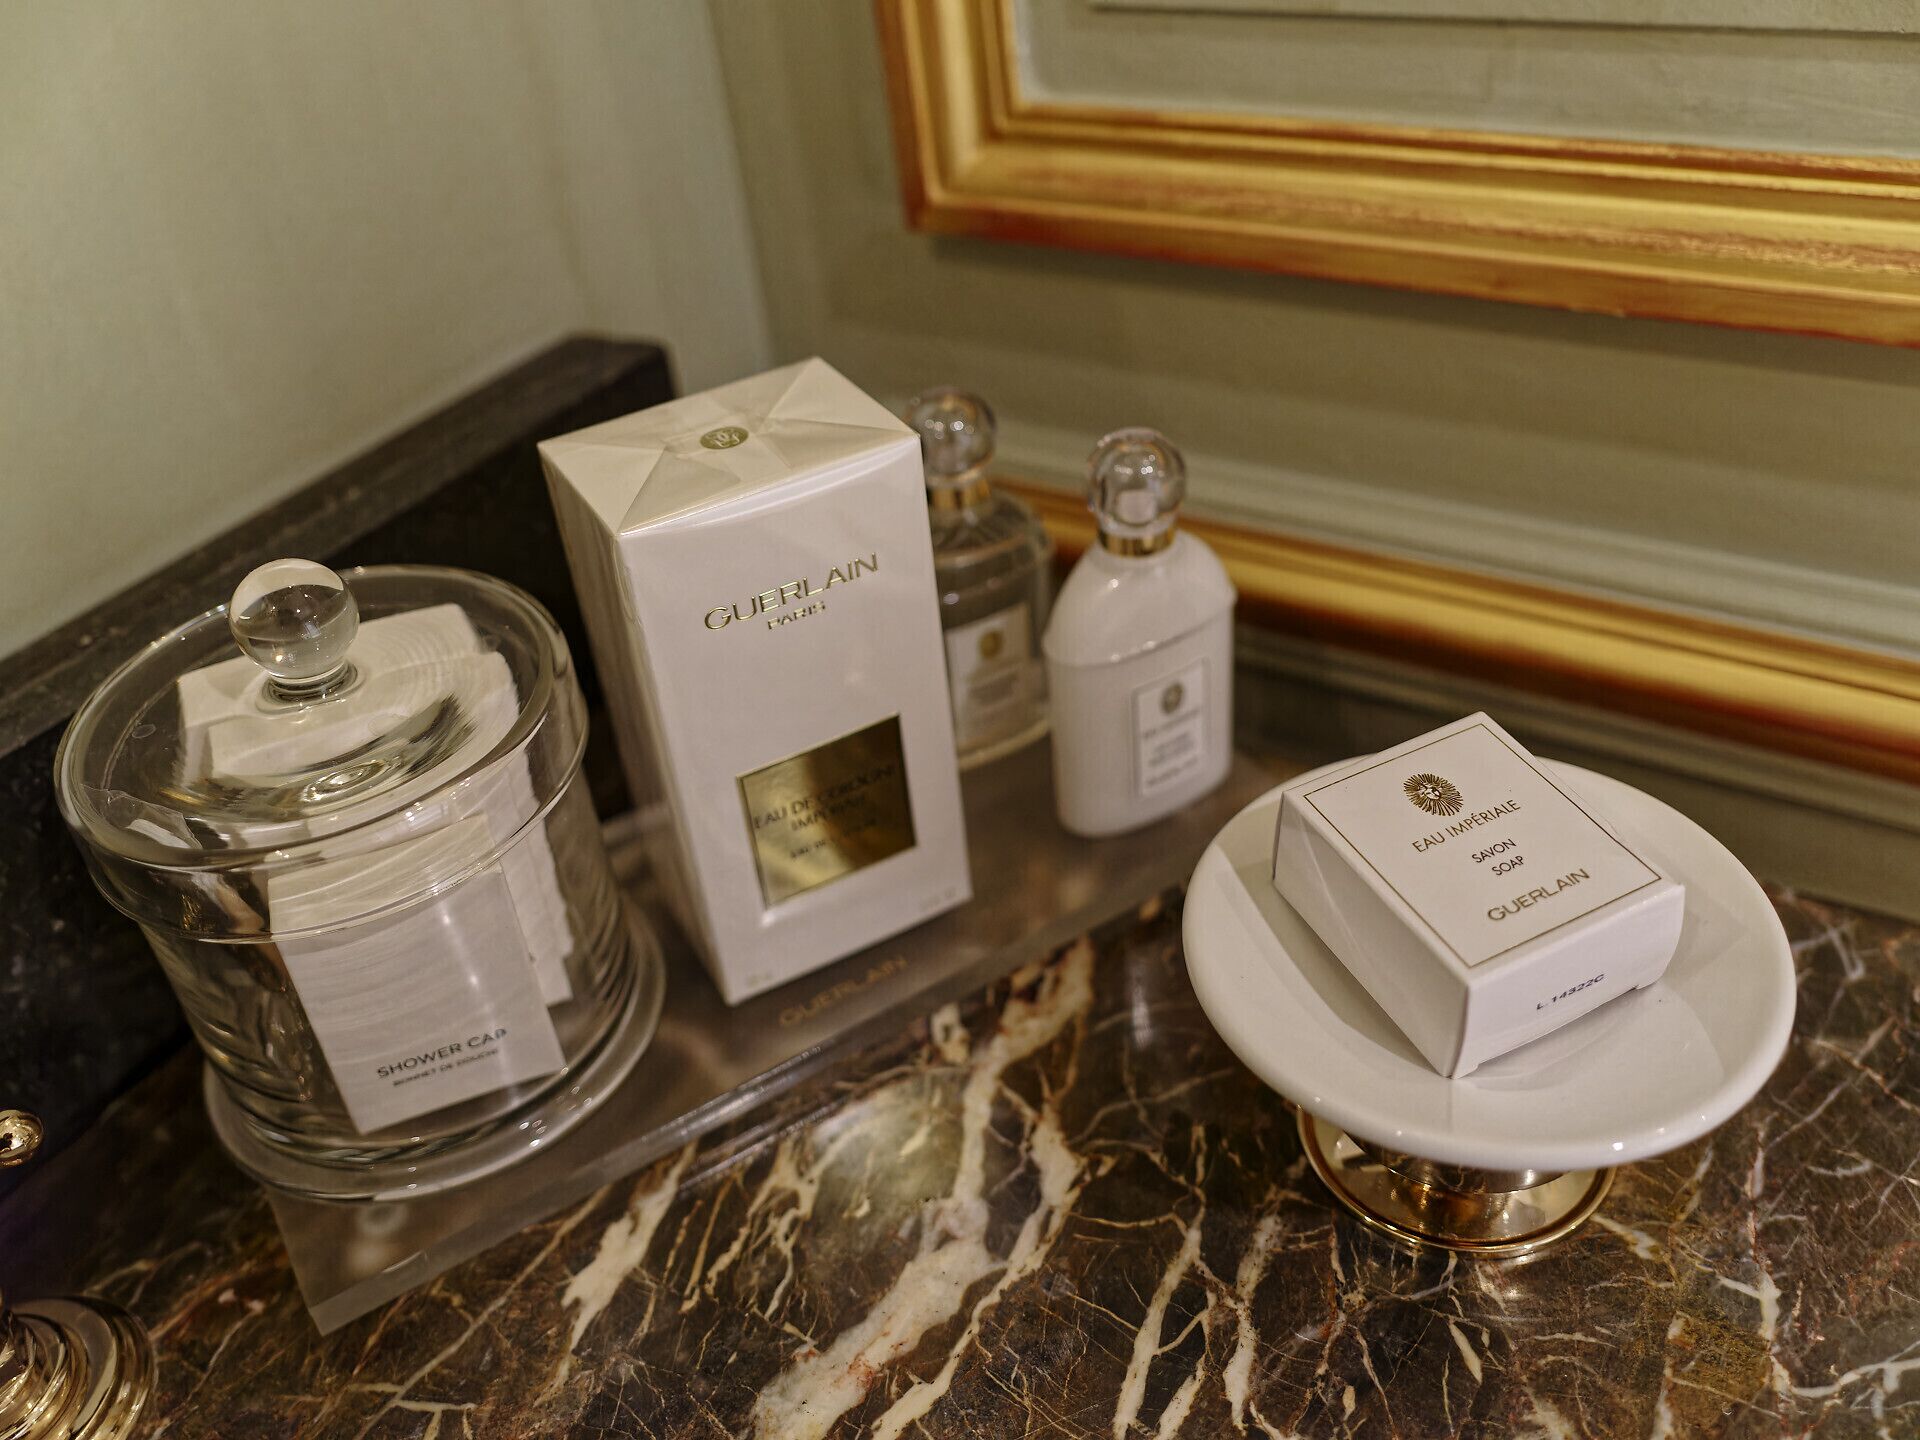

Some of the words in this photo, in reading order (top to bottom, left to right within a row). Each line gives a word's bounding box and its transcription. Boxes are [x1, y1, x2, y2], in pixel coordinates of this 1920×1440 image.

[704, 552, 878, 630] GUERLAIN
[767, 601, 826, 630] PARIS
[1412, 832, 1445, 853] EAU
[1446, 799, 1521, 838] IMPÉRIALE
[1471, 838, 1517, 864] SAVON
[1492, 855, 1524, 876] SOAP
[1487, 868, 1590, 921] GUERLAIN
[376, 1042, 462, 1078] SHOWER
[467, 1028, 507, 1048] CAP
